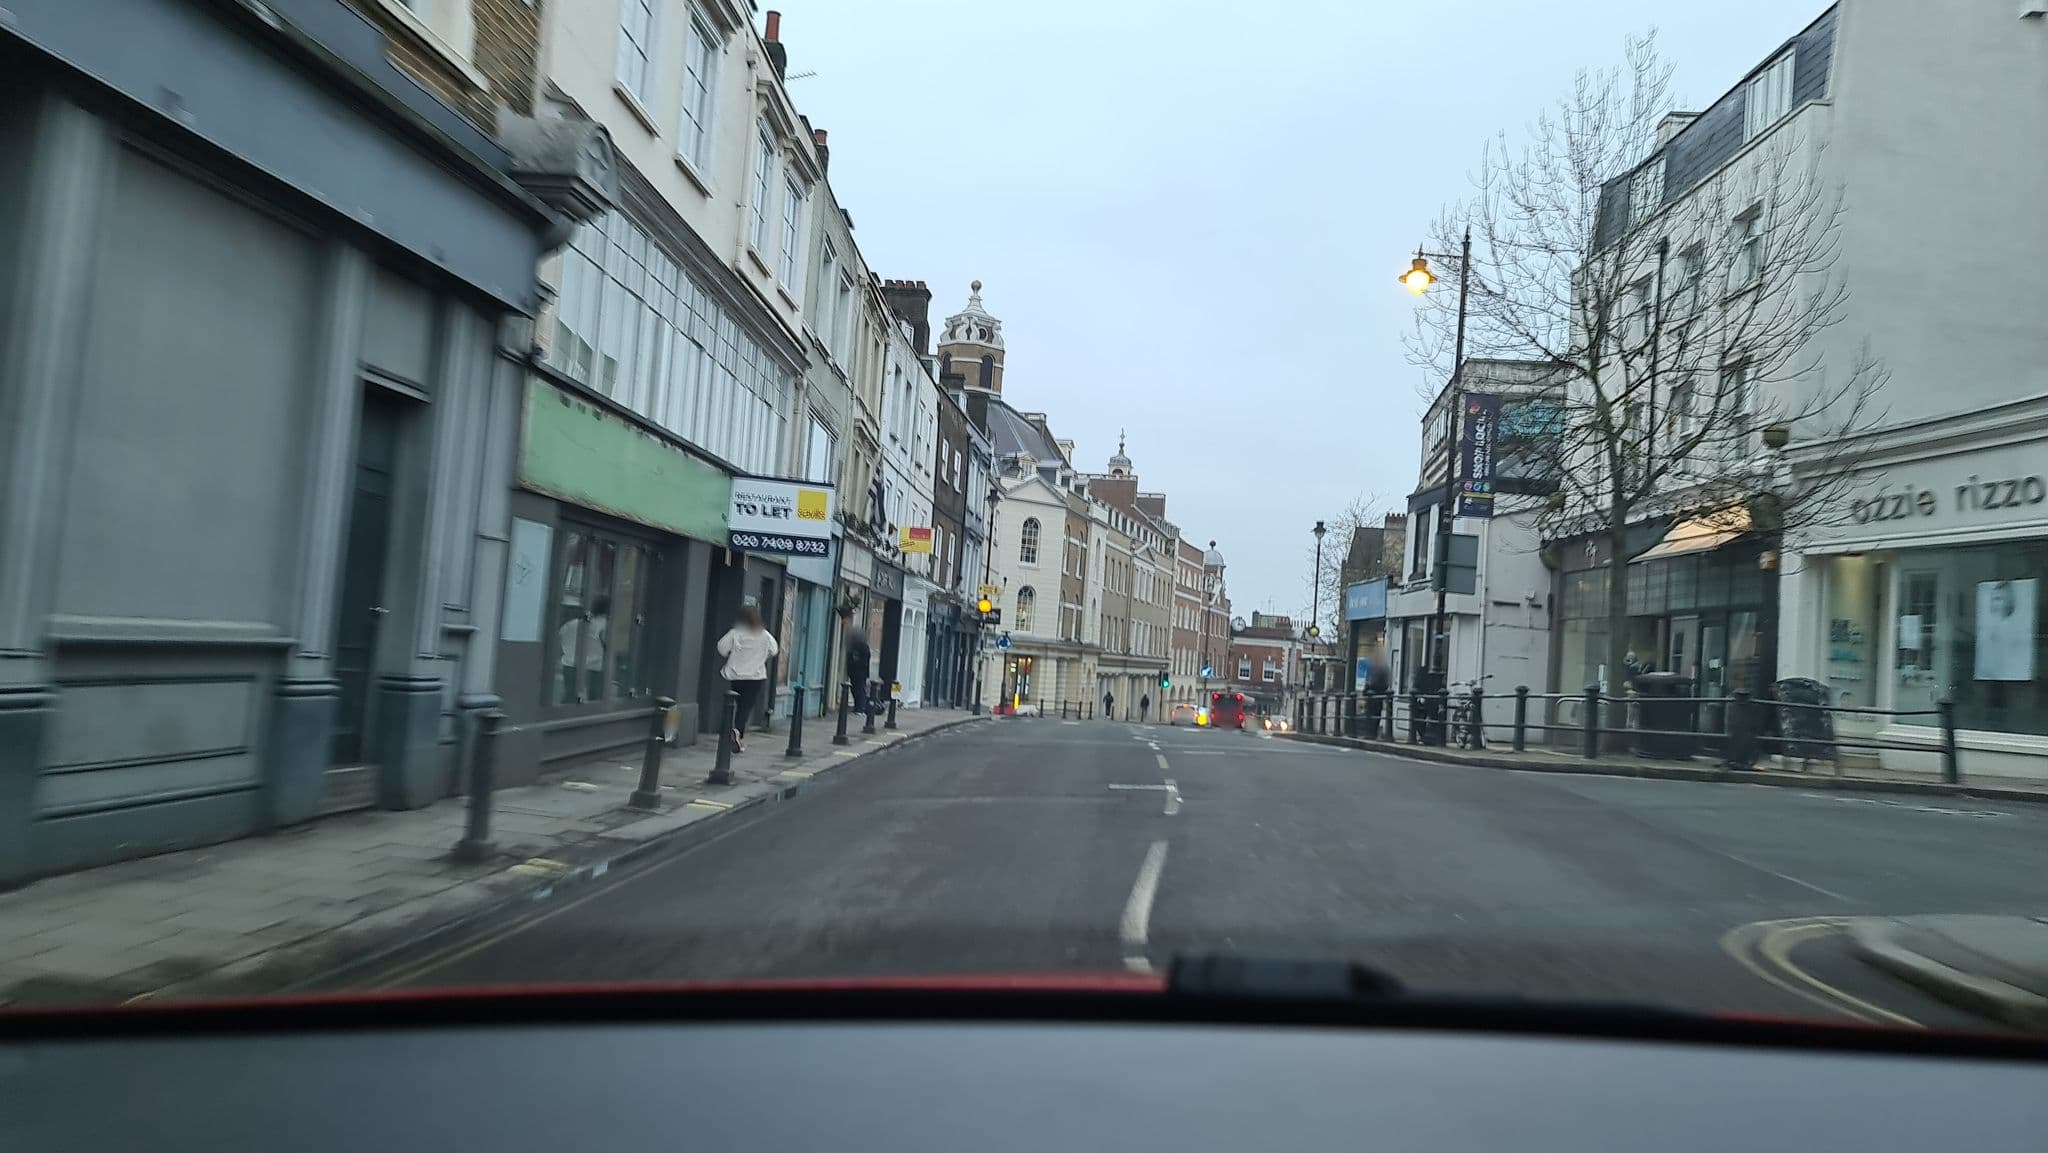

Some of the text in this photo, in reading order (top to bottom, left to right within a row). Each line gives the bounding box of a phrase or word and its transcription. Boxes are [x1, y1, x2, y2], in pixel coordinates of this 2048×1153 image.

[735, 491, 792, 504] RESTAURANT
[1851, 474, 2046, 524] ozzie rizzo
[734, 501, 793, 520] TO LET
[732, 534, 825, 553] 020 7409 8732
